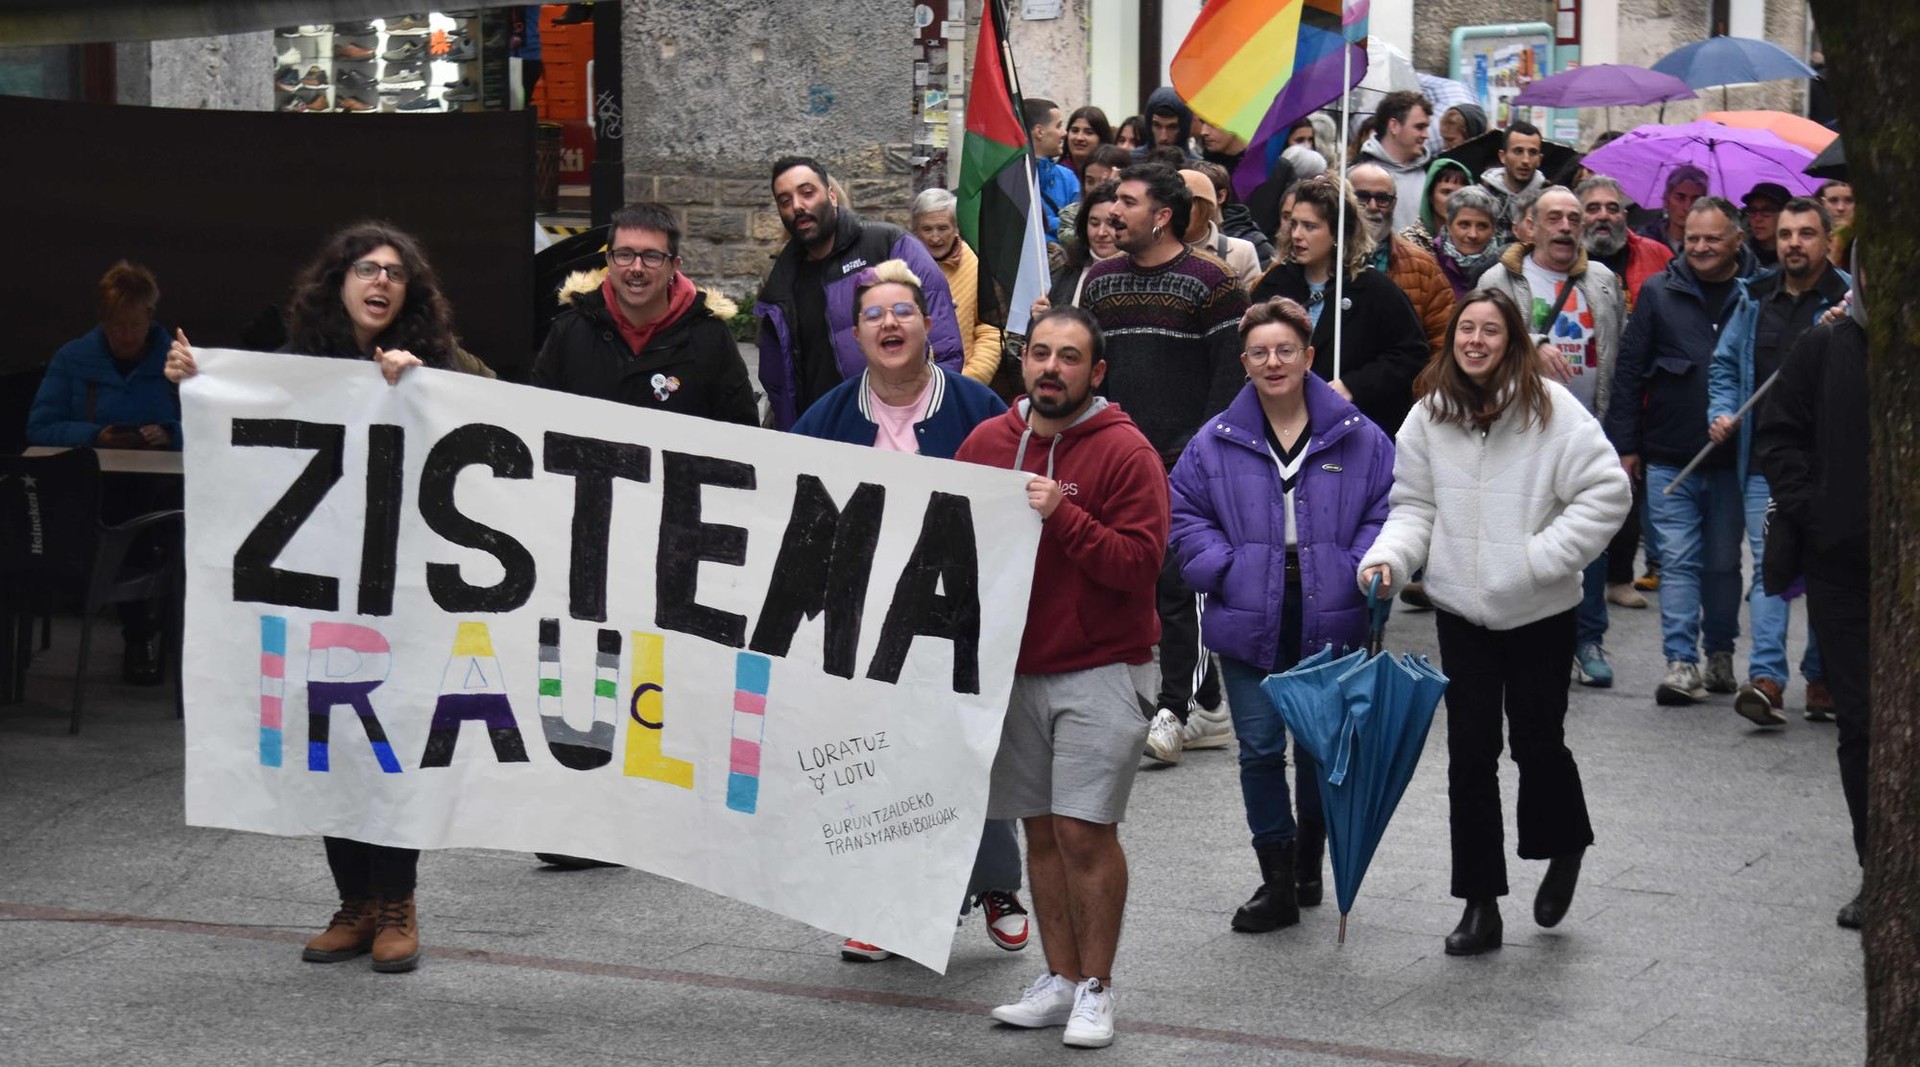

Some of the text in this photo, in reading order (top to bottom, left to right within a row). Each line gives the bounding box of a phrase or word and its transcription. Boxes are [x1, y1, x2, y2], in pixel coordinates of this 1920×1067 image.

[29, 492, 43, 554] Heineken
[232, 418, 981, 695] ZISTEMA
[260, 615, 771, 815] IRAULI
[797, 731, 890, 772] LORATUZ
[834, 759, 875, 787] LOTU
[822, 792, 934, 838] BURUNTZALDEKO
